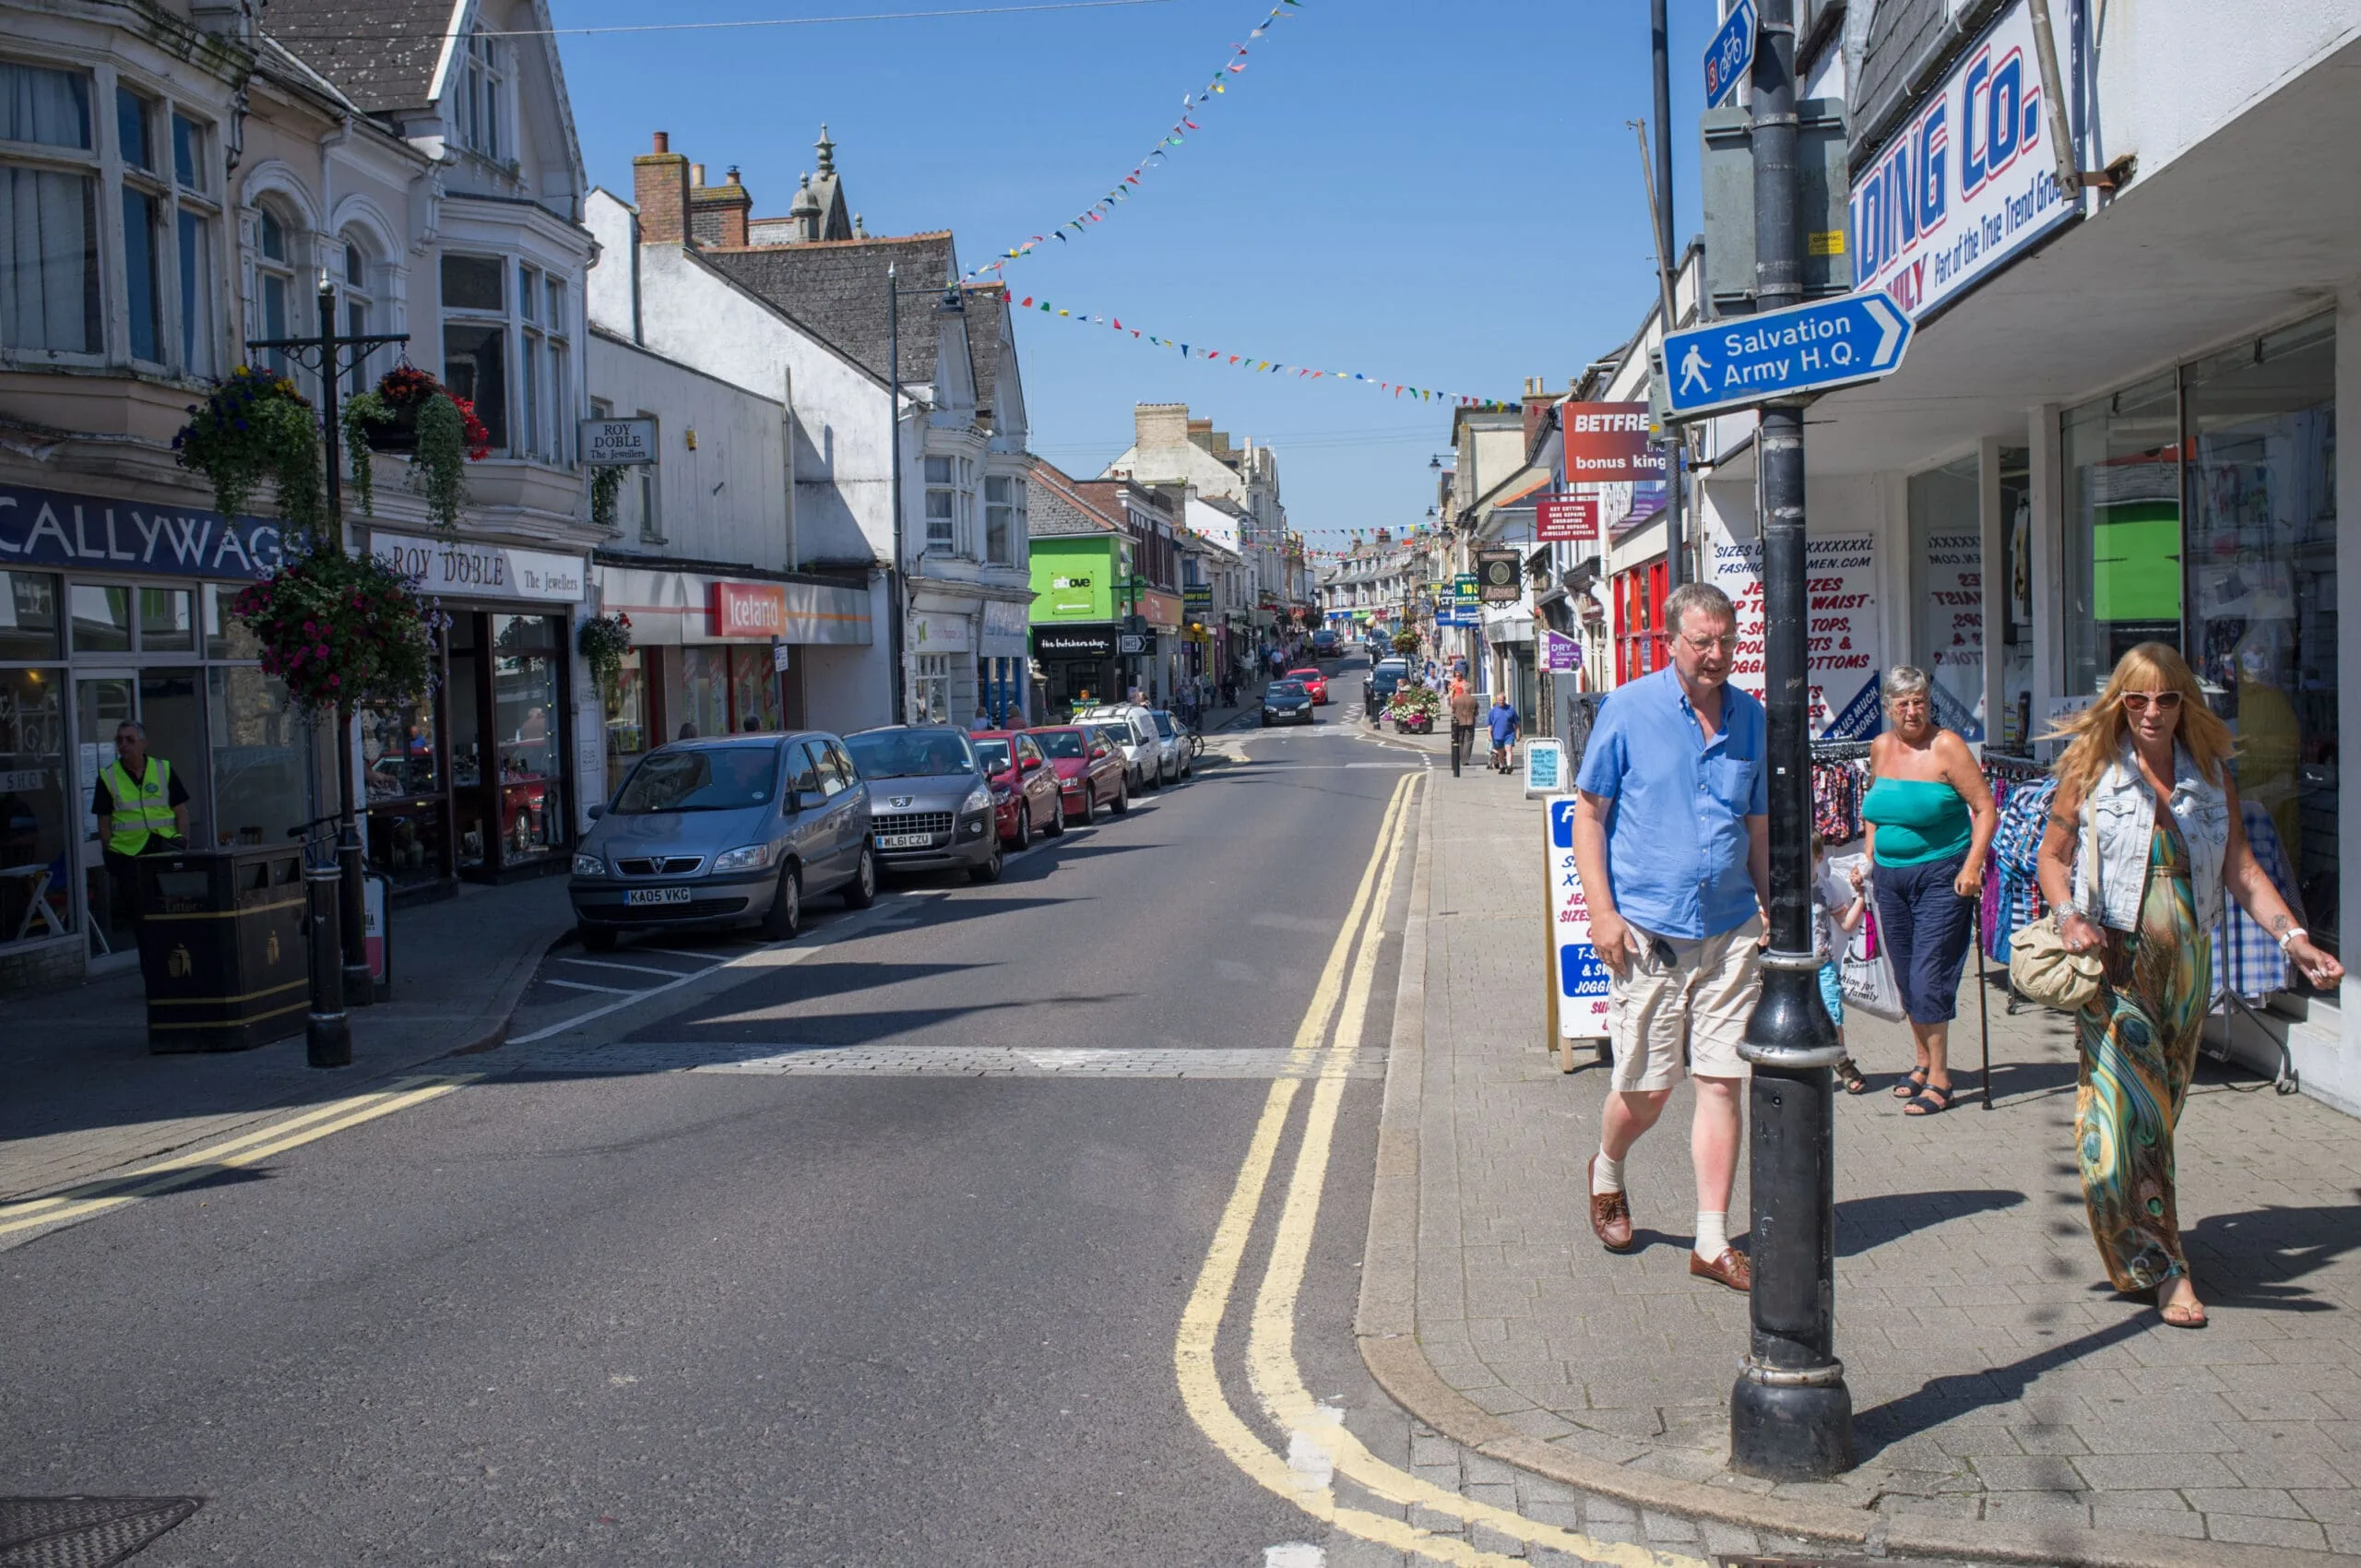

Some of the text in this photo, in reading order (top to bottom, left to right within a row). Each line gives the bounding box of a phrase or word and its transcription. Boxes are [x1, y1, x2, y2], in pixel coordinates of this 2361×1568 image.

[1709, 68, 1716, 88] 3
[1960, 42, 2041, 203] Co.
[1934, 252, 1952, 288] Part
[1952, 241, 1963, 274] of
[1964, 228, 1979, 266] the
[1981, 210, 2002, 253] True
[2004, 176, 2035, 236] Trend
[1725, 316, 1851, 357] Salvation
[1724, 341, 1861, 387] Army H.Q.
[604, 424, 631, 435] ROY
[1574, 413, 1650, 433] BETFRE
[594, 435, 642, 447] DOBLE
[590, 450, 606, 459] The
[1575, 454, 1667, 470] bonus king
[1714, 544, 1752, 558] SIZES
[393, 545, 504, 586] ROY DOBLE
[524, 569, 578, 592] The Jewellers
[1053, 576, 1090, 589] above
[1485, 586, 1516, 599] ARMS
[730, 593, 779, 627] Iceland
[1810, 594, 1869, 611] WAIST
[1810, 617, 1852, 633] TOPS,
[1041, 638, 1055, 648] the
[1056, 638, 1088, 647] butchers
[1551, 644, 1572, 652] DRY
[1839, 636, 1853, 650] &
[1833, 685, 1880, 741] PLUS MUCH
[1851, 708, 1881, 741] MORE!
[884, 835, 929, 847] WL61 CZU
[630, 888, 688, 903] KA05 VKG
[1582, 963, 1592, 977] &
[1862, 980, 1875, 992] for
[1848, 987, 1879, 1003] family
